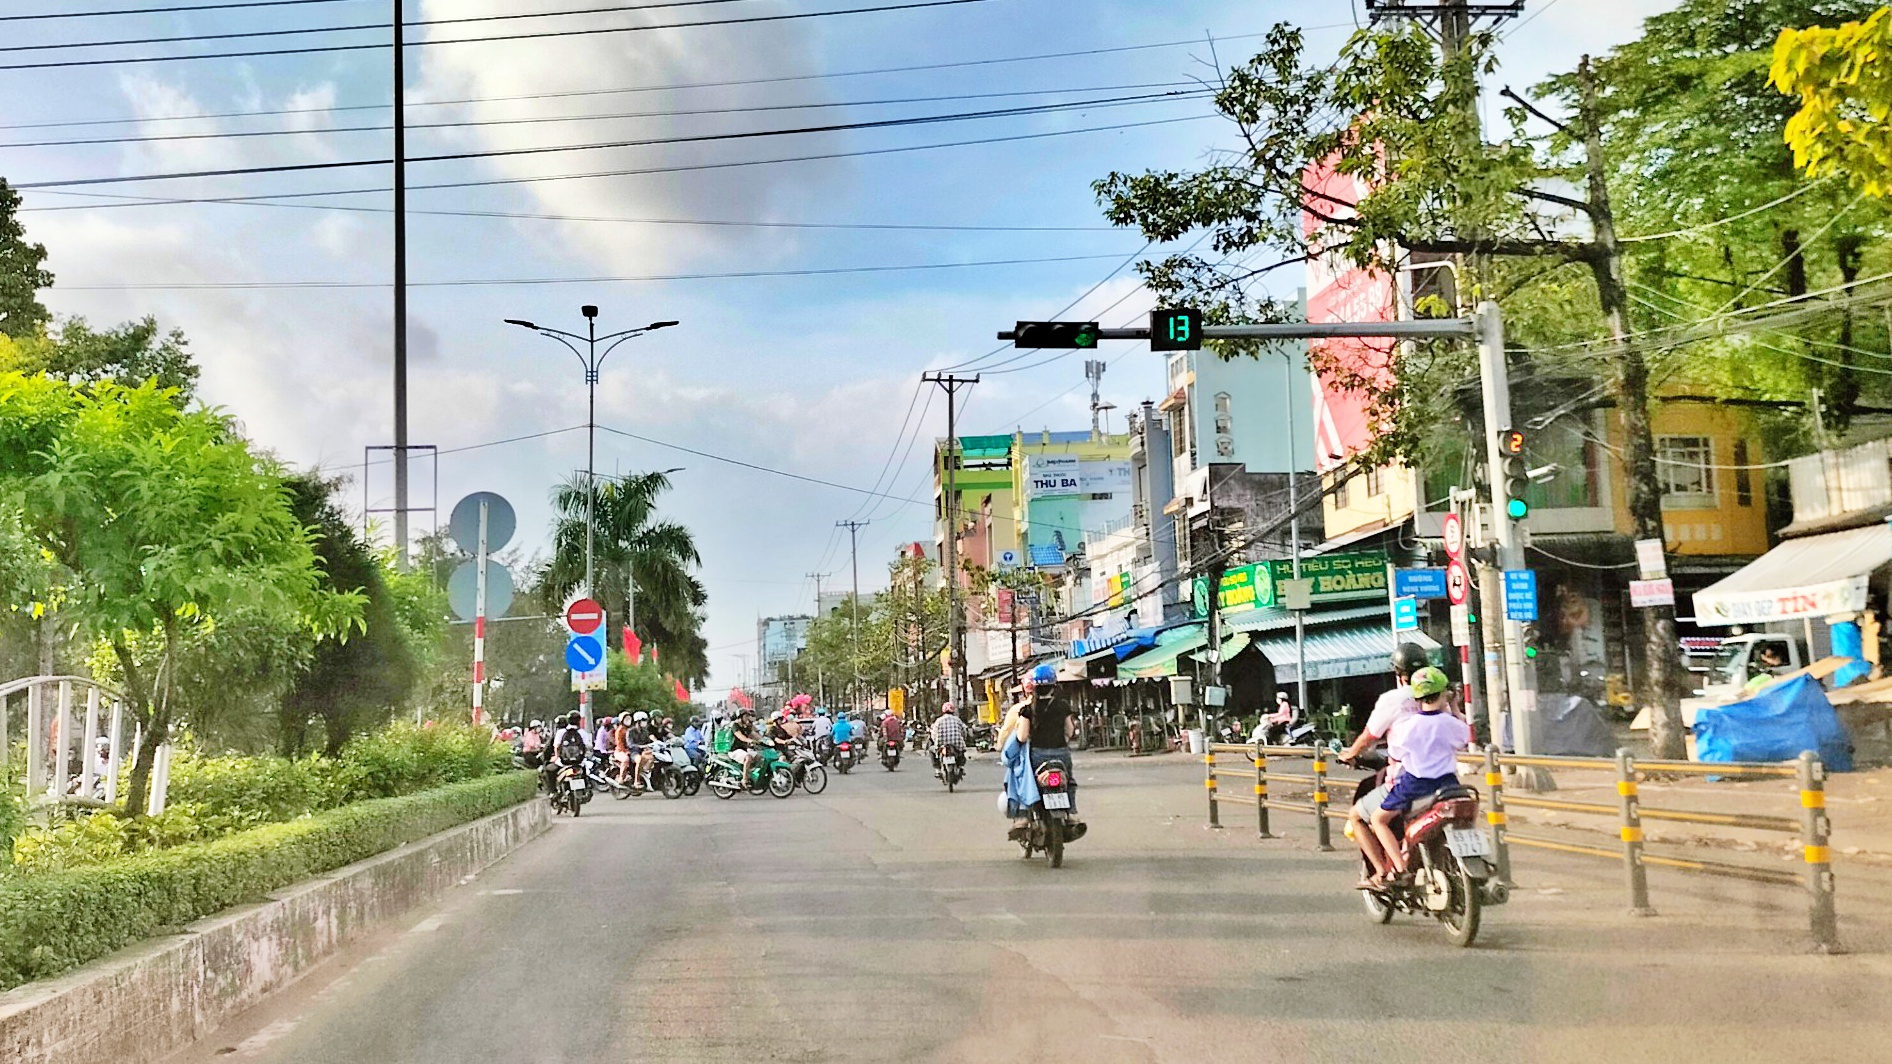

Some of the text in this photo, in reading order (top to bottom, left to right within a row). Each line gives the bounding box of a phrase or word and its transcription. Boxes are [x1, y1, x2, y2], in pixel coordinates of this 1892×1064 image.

[1169, 315, 1189, 342] 13
[1509, 433, 1524, 452] 2
[1033, 479, 1077, 489] THU BA
[1319, 570, 1386, 593] HOÀNG
